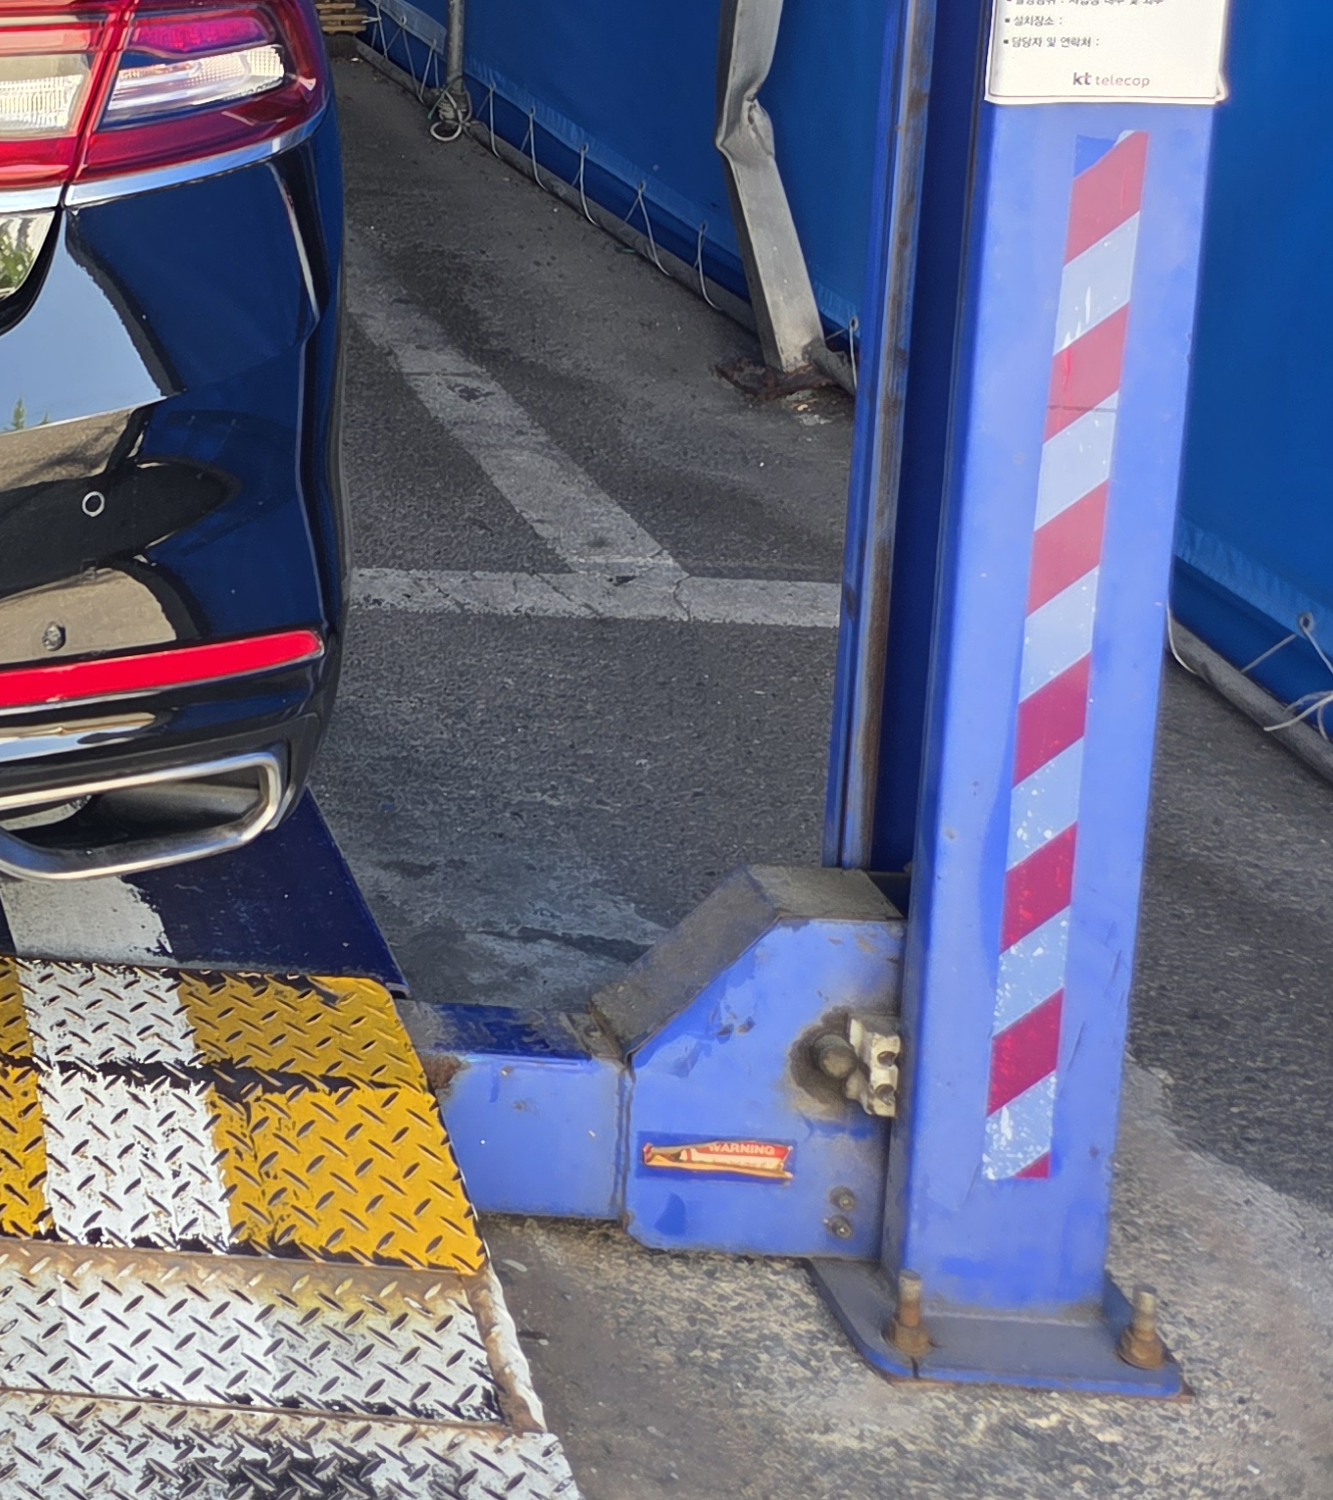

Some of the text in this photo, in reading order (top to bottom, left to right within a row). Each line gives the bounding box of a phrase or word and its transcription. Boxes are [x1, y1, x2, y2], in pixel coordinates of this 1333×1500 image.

[1072, 71, 1151, 89] kt telecop
[709, 1141, 775, 1156] WARNING
